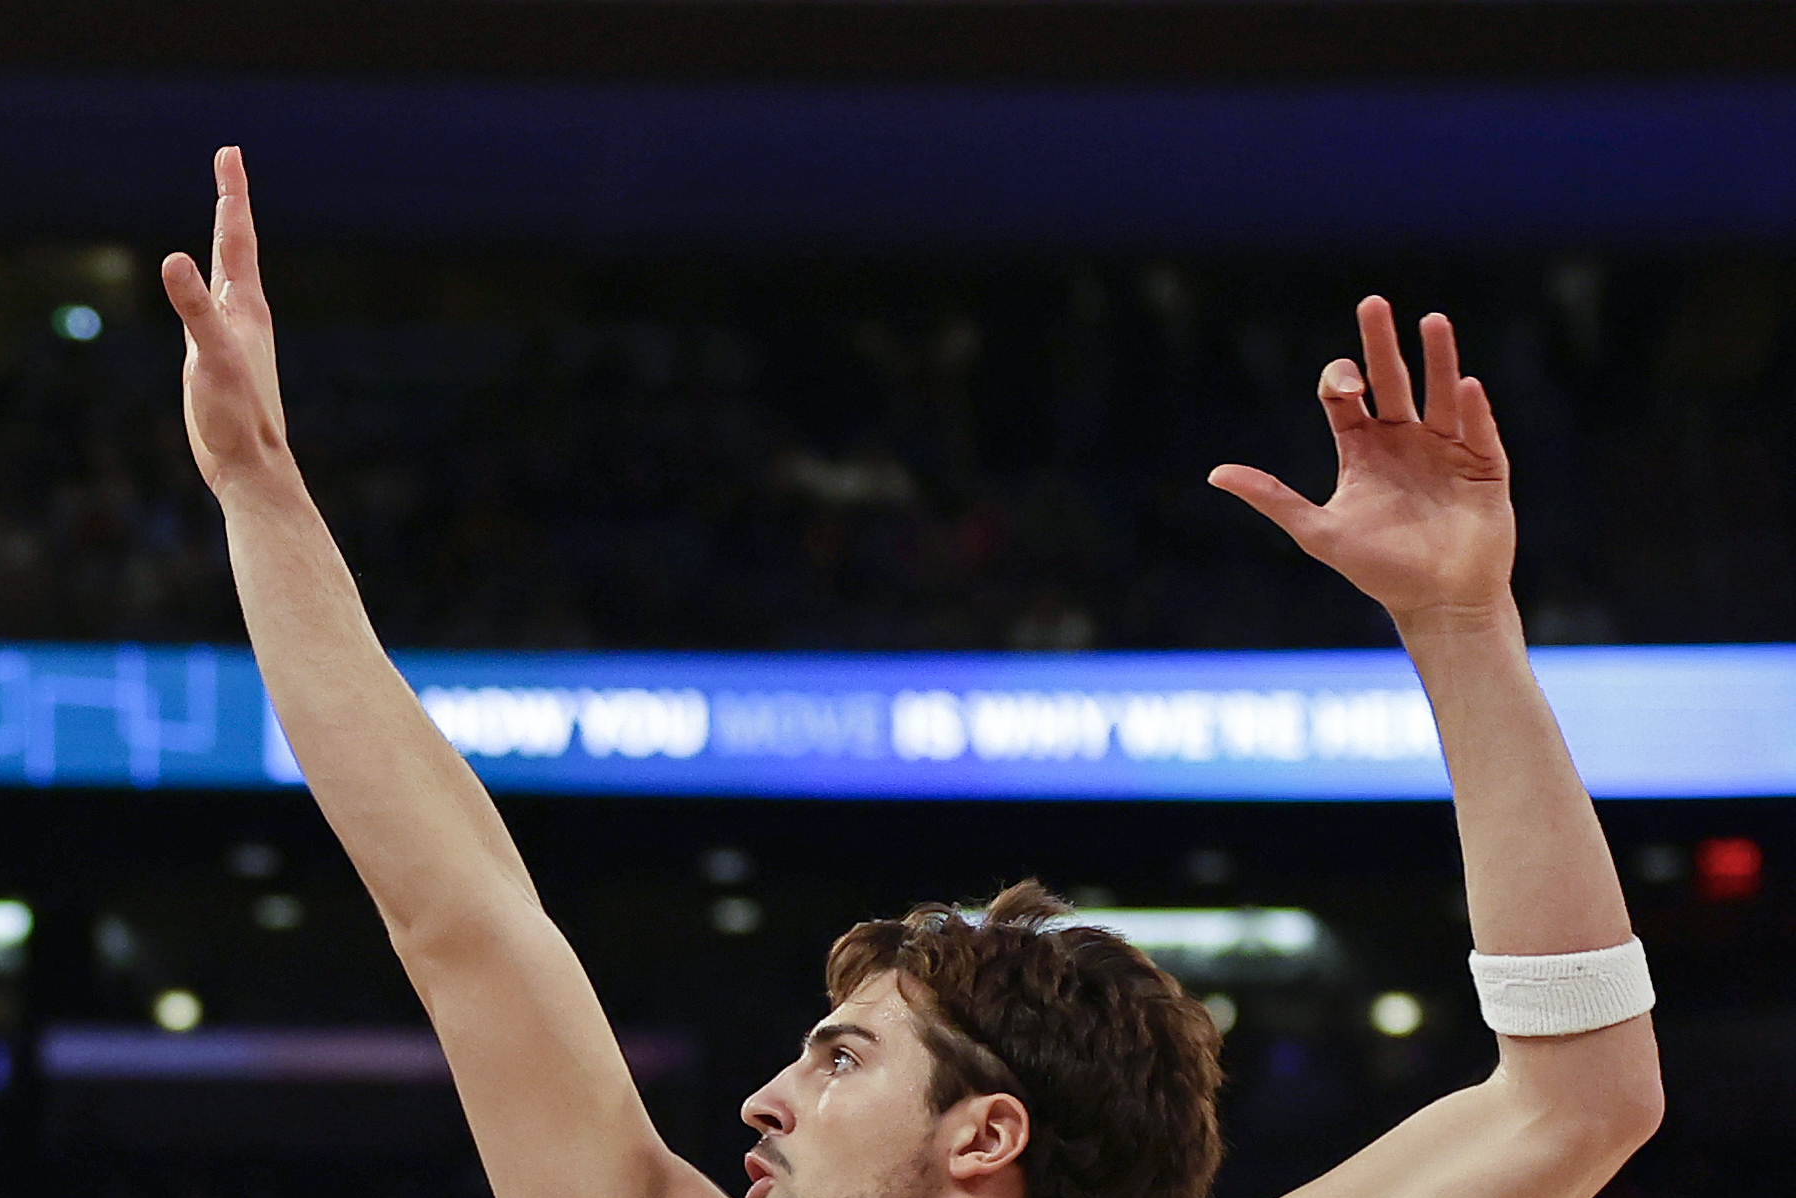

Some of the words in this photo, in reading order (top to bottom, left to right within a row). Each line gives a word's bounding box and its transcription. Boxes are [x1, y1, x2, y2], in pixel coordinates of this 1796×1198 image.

[579, 690, 709, 758] YOU
[891, 691, 967, 760] IS
[971, 691, 1112, 760] WHY
